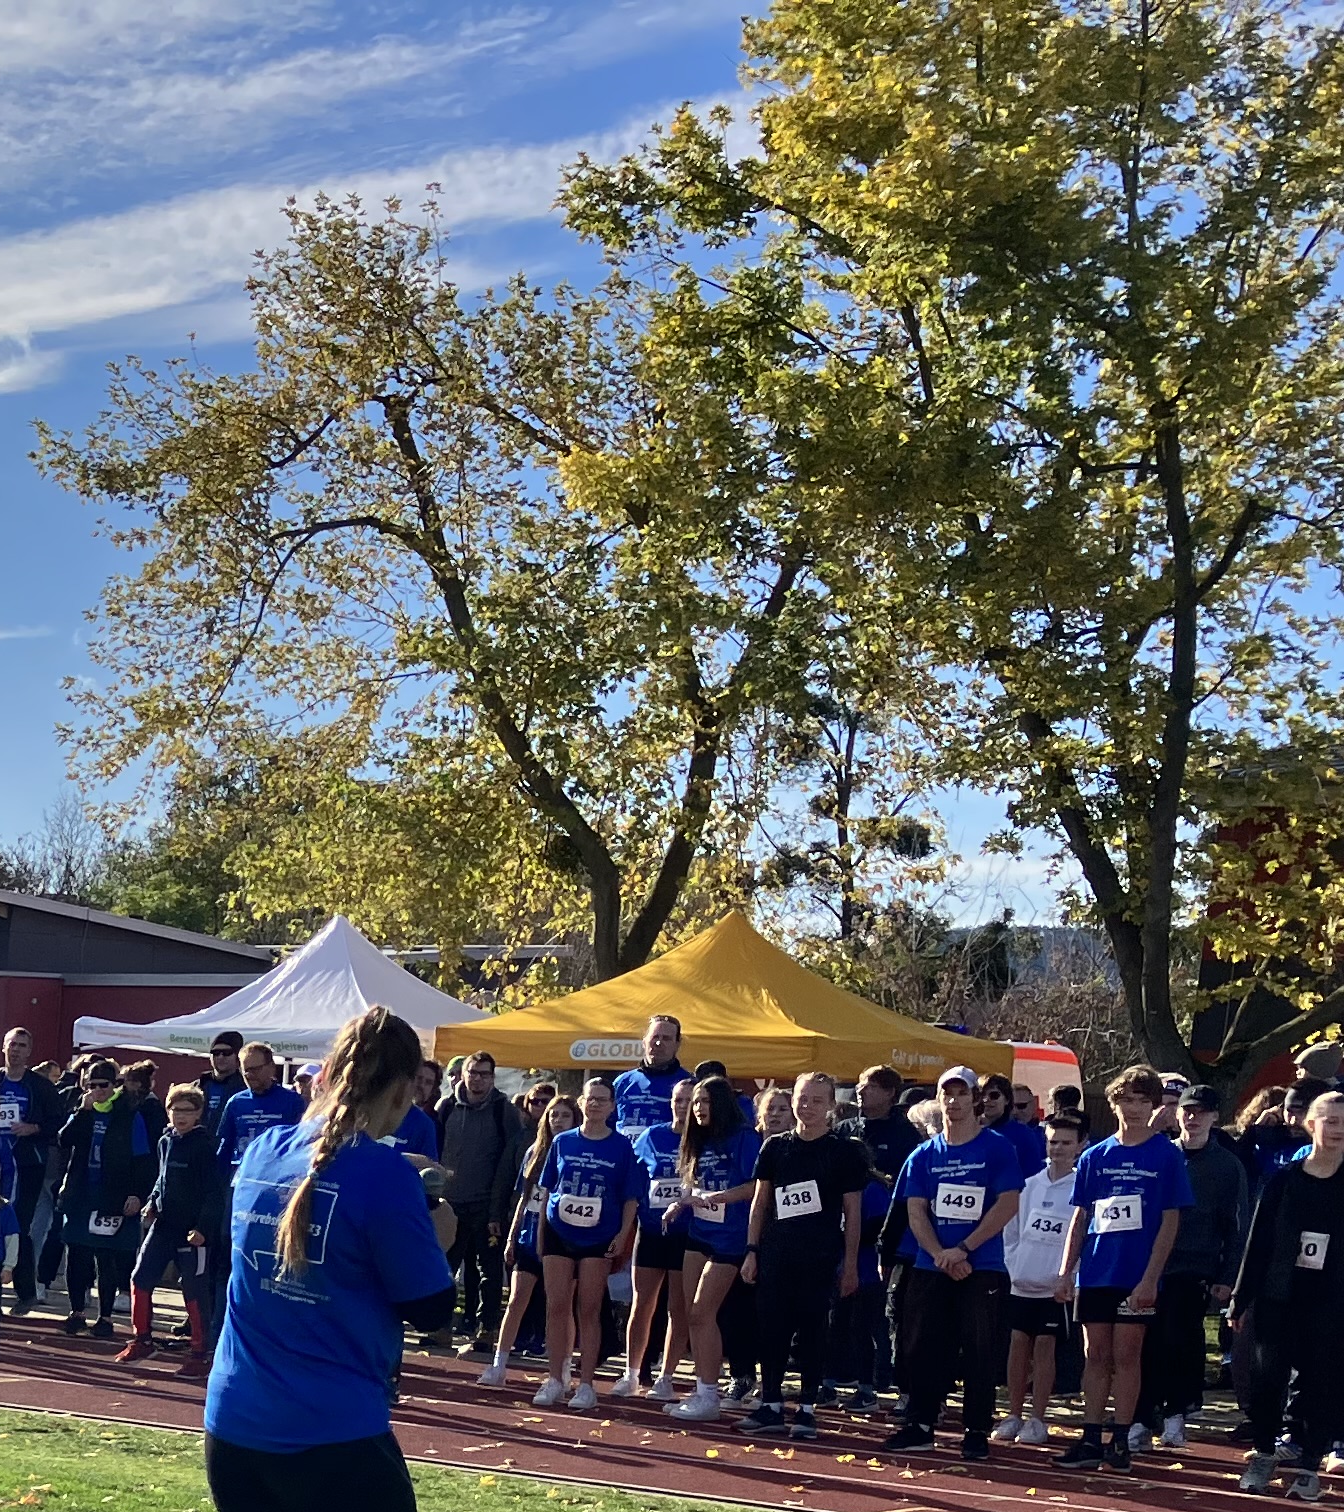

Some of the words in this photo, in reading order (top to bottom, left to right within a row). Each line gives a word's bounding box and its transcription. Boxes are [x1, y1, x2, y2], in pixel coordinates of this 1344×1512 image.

[588, 1043, 647, 1058] GLOBU
[654, 1187, 682, 1198] 425
[782, 1191, 812, 1207] 438
[942, 1194, 976, 1208] 449
[564, 1204, 593, 1217] 442
[1102, 1205, 1131, 1219] 431
[1032, 1219, 1063, 1234] 434
